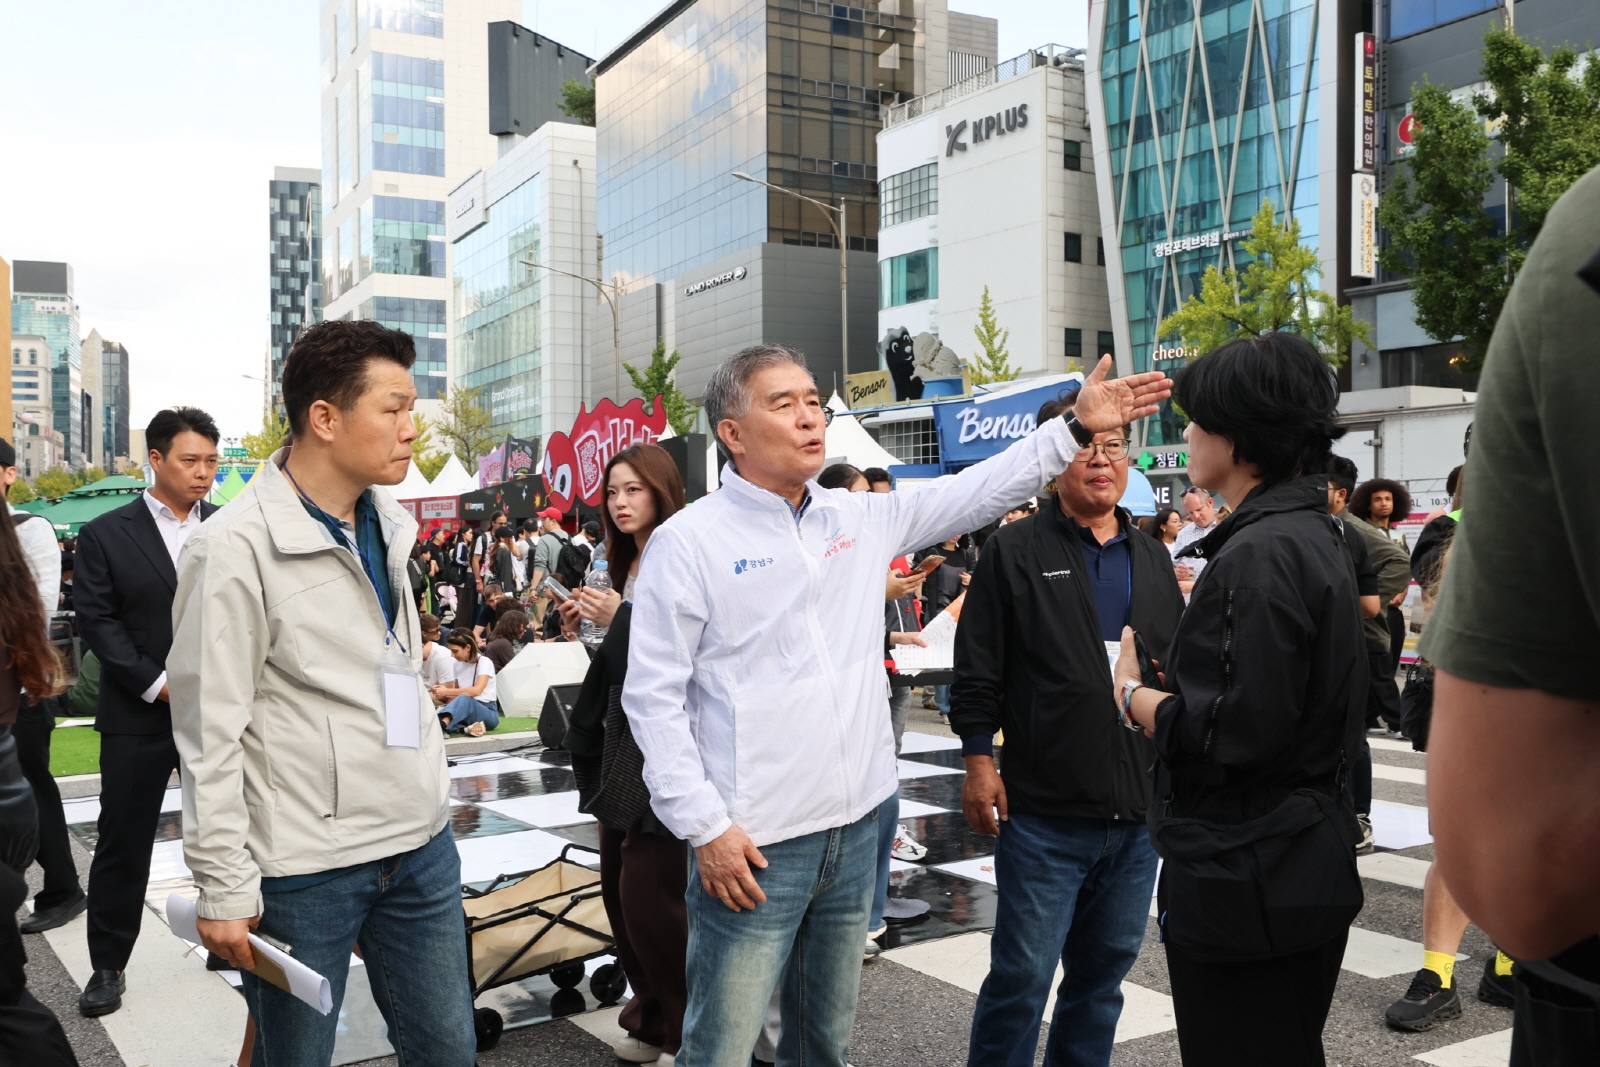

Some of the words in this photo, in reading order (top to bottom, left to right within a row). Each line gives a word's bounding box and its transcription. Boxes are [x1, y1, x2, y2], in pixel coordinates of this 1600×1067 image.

[973, 103, 1028, 144] KPLUS
[1364, 66, 1374, 165] 토마토한의원
[1154, 231, 1220, 257] 청담포레브의원
[684, 282, 705, 296] LAND
[706, 272, 733, 289] ROVER
[851, 378, 887, 403] Benson
[955, 407, 1037, 444] Benso
[749, 557, 774, 569] 강남구
